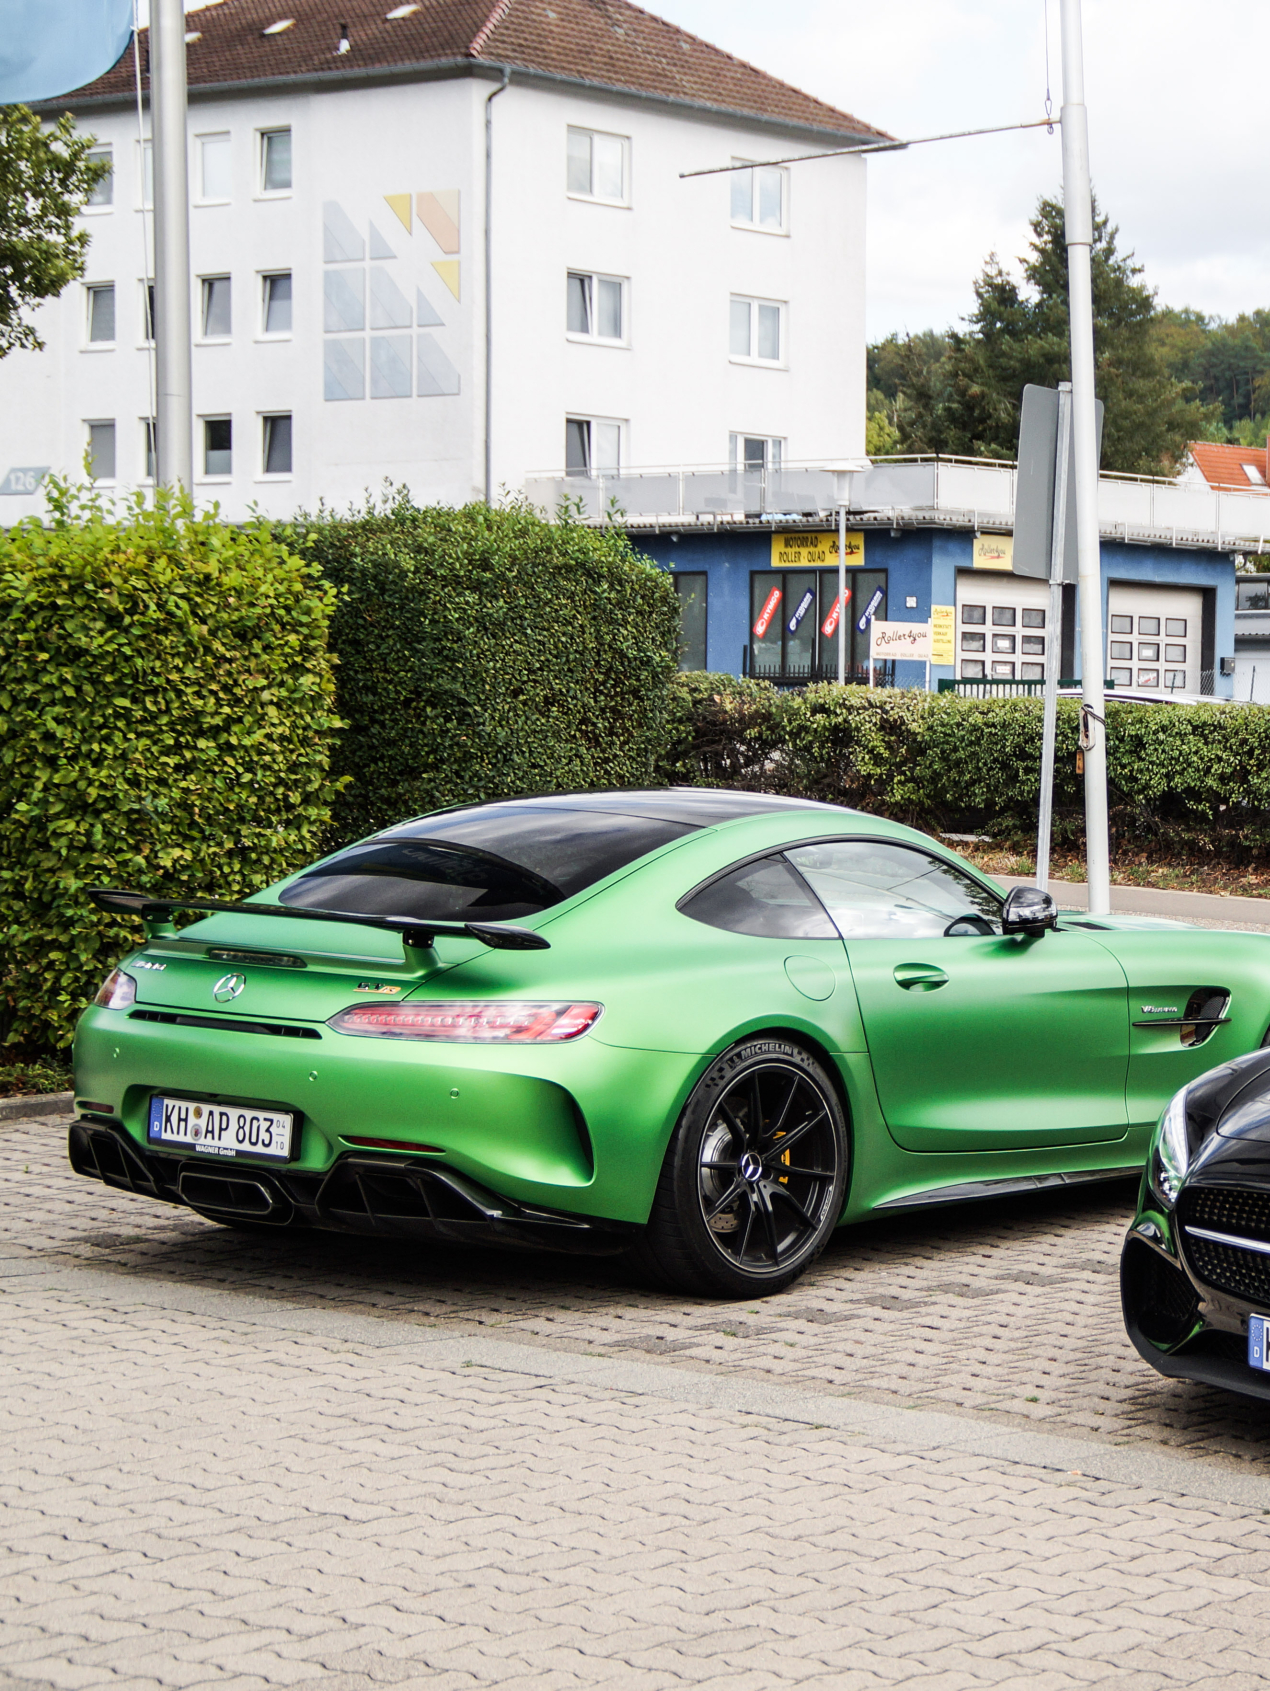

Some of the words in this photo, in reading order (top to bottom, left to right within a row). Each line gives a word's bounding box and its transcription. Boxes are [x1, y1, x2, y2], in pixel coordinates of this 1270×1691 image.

[9, 470, 37, 491] 126
[784, 536, 819, 549] MOTORRAD
[779, 551, 801, 563] ROLLER
[807, 551, 826, 563] QUAD
[764, 590, 779, 620] KYMCO
[876, 630, 927, 647] Roller4you
[740, 1043, 793, 1060] MICHELIN
[153, 1122, 160, 1131] D
[164, 1103, 189, 1137] KH
[204, 1110, 230, 1141] AP
[236, 1114, 274, 1148] 803
[276, 1119, 286, 1129] 04
[195, 1144, 219, 1155] WAGNER
[219, 1147, 236, 1157] GmbH
[275, 1141, 285, 1151] 10
[1253, 1346, 1260, 1358] D
